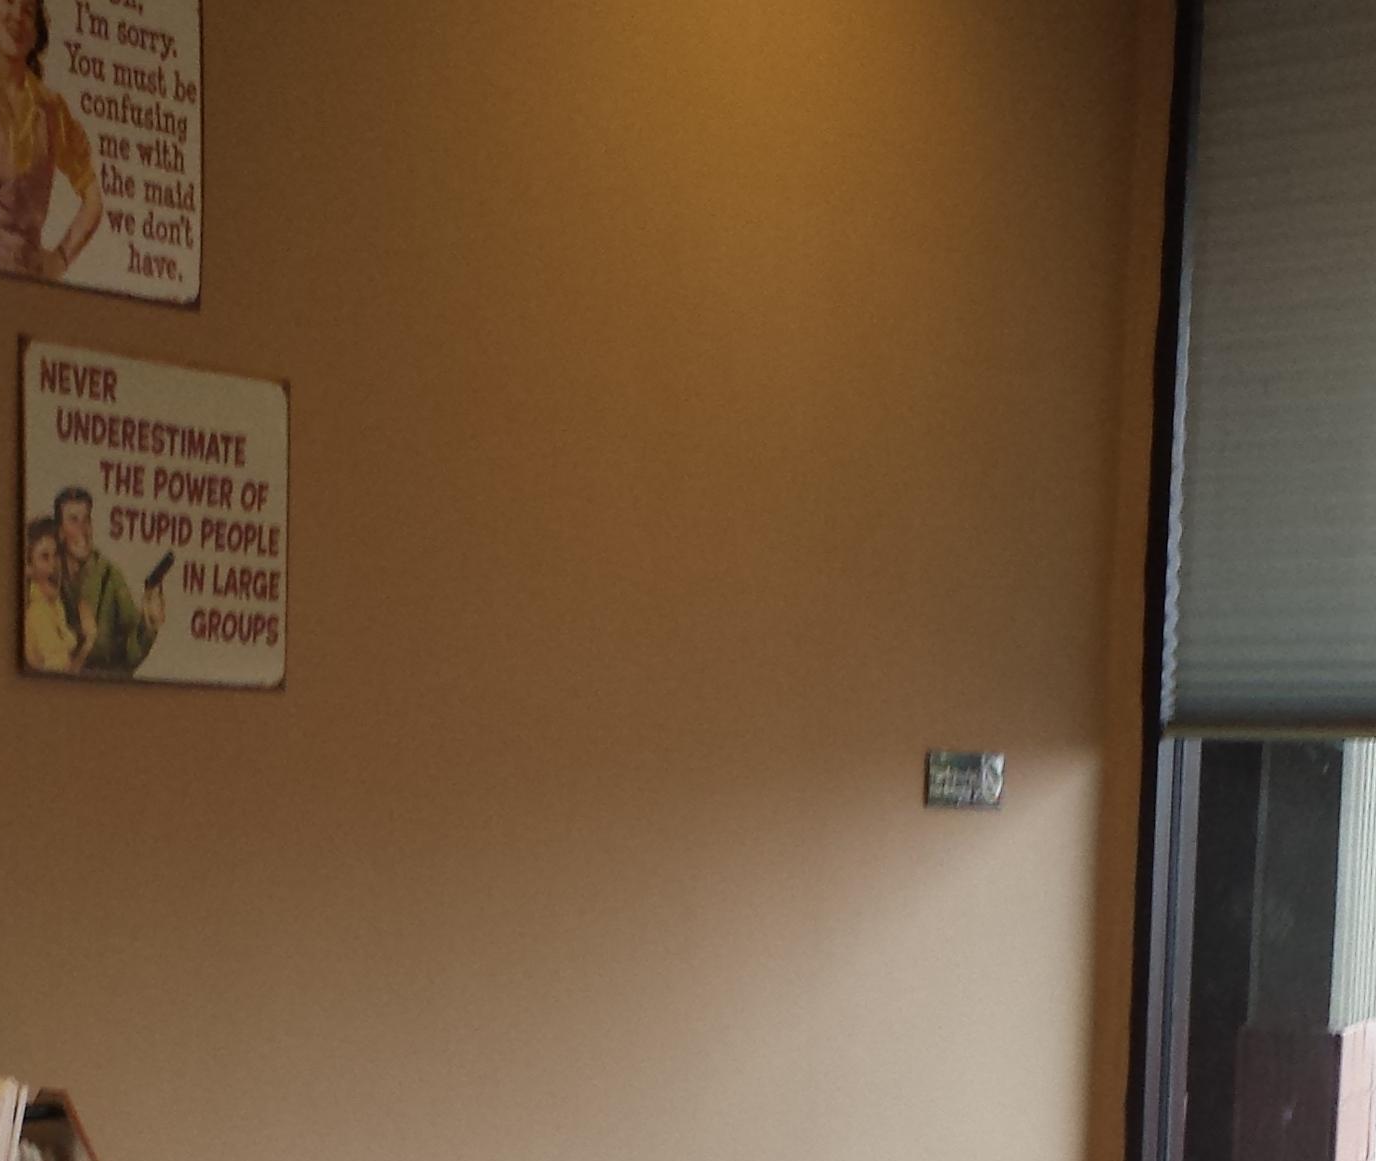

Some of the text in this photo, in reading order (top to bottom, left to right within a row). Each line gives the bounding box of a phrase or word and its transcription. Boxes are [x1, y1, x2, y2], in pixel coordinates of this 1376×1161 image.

[75, 1, 109, 40] I'm
[64, 40, 197, 103] You must be
[80, 91, 188, 144] confusing
[99, 133, 184, 174] me with
[101, 163, 195, 212] the maid
[106, 209, 194, 250] we don't
[128, 241, 184, 283] have.
[40, 356, 118, 402] NEVER
[57, 406, 247, 468] UNDERESTIMATE
[100, 460, 269, 513] THE POWER OF
[110, 505, 280, 558] STUPID PEOPLE
[183, 560, 281, 602] IN LARGE
[191, 609, 279, 647] GROUPS
